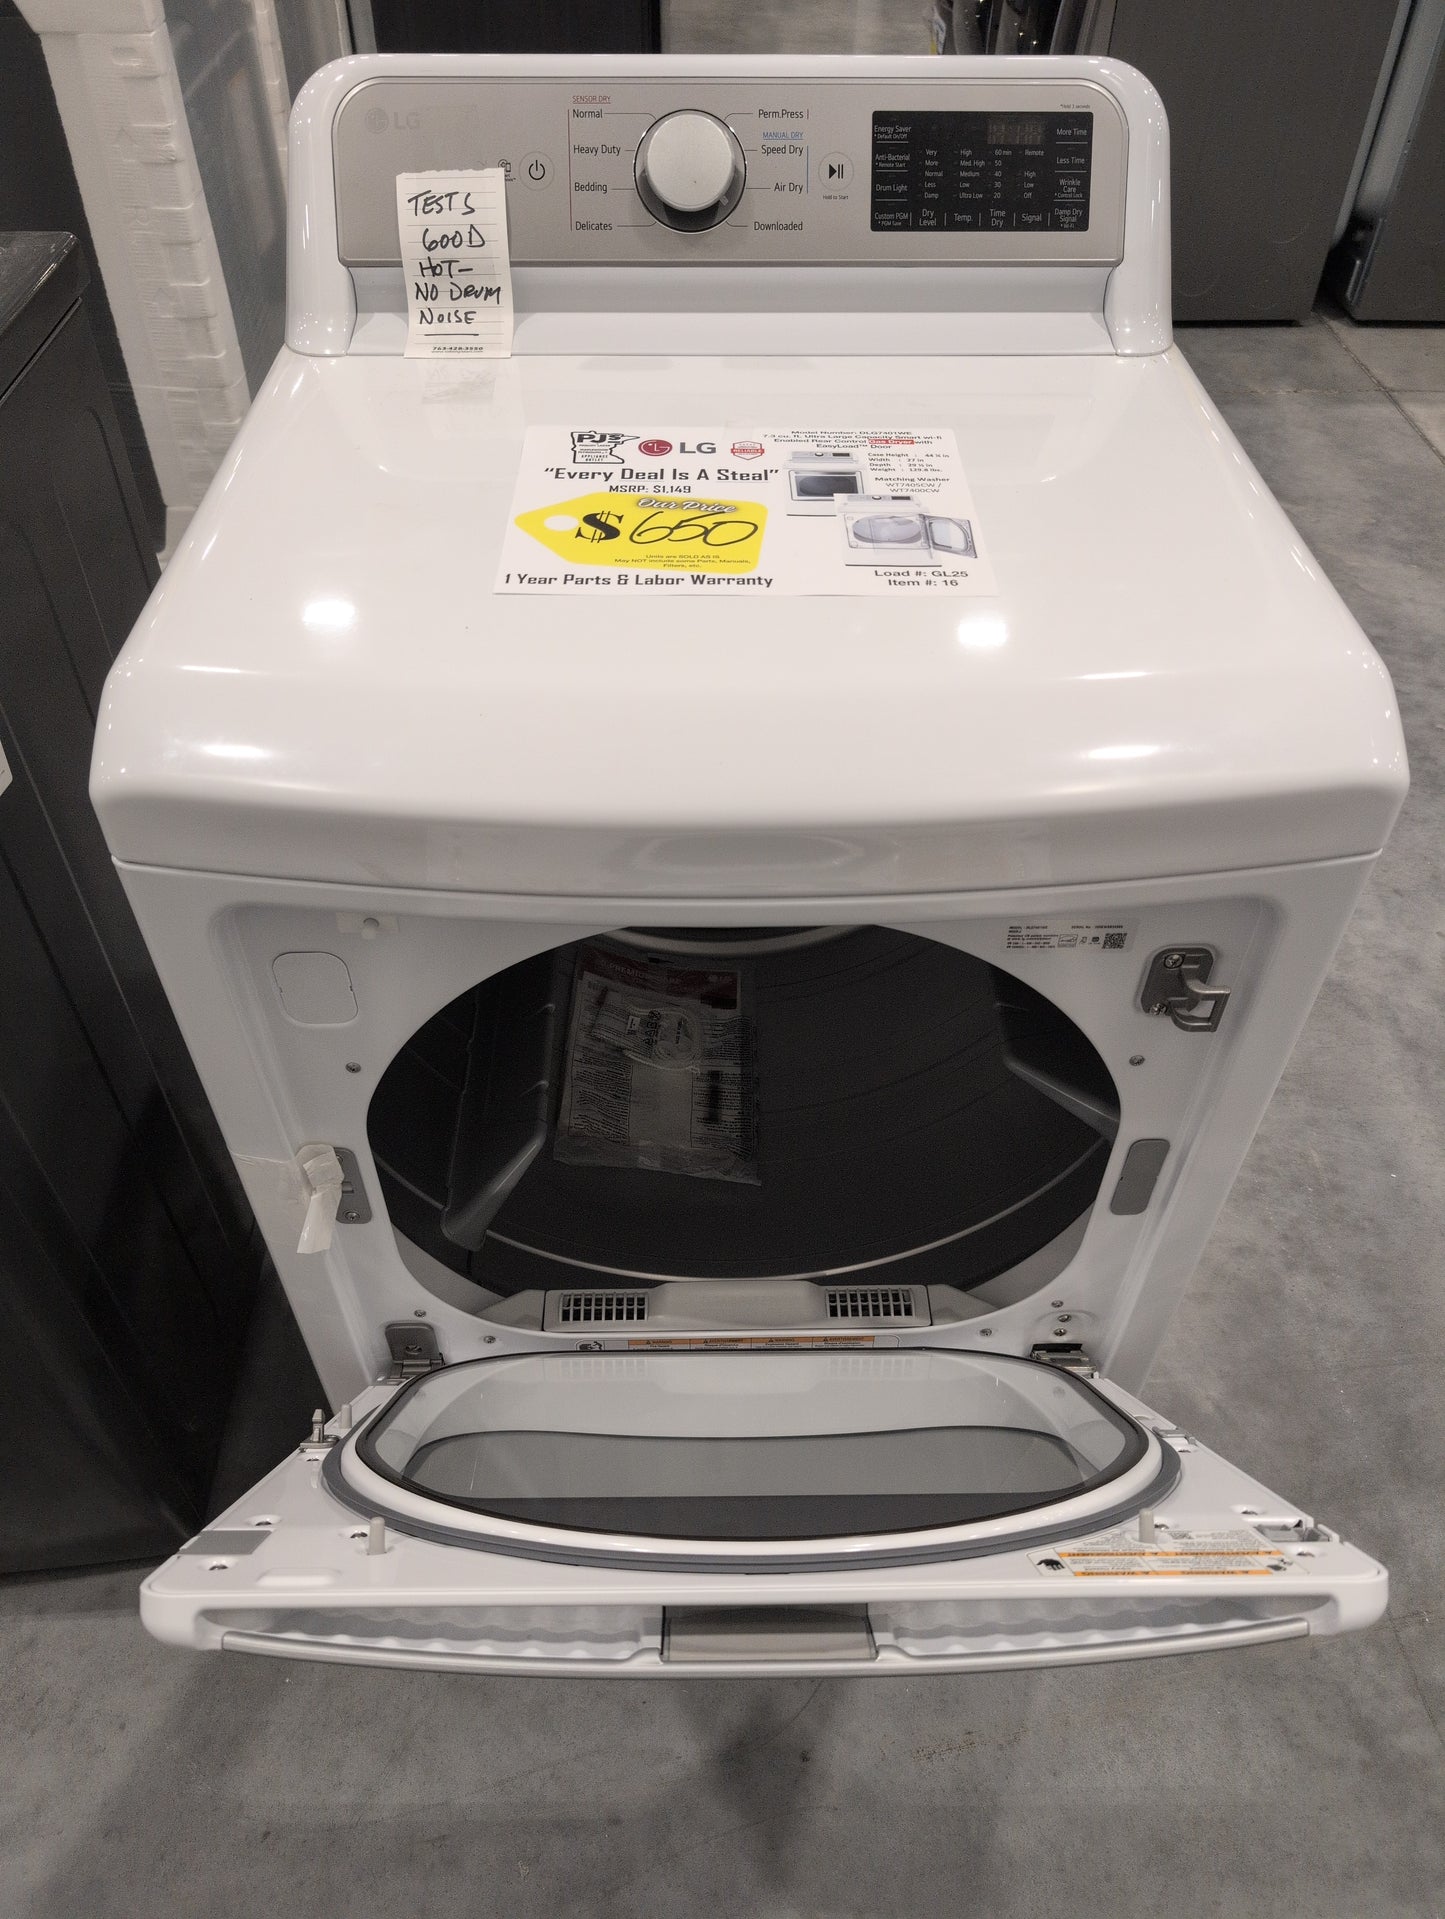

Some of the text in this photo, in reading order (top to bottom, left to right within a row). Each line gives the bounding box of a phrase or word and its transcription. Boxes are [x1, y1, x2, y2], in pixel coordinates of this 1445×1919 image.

[599, 95, 611, 103] DRY
[572, 109, 603, 119] Normal
[758, 109, 804, 119] Perm.Press
[874, 125, 894, 133] Energy
[1073, 128, 1088, 136] Time
[573, 145, 621, 156] Heavy Duty
[761, 145, 804, 156] Speed Dry
[926, 149, 938, 157] Very
[960, 149, 972, 157] High
[973, 160, 986, 168] High
[1056, 156, 1086, 164] Less Time
[1024, 170, 1036, 178] High
[1060, 178, 1080, 186] Wrinkle
[574, 182, 608, 193] Bedding
[774, 182, 804, 194] Air Dry
[893, 184, 908, 193] Light
[874, 212, 909, 220] Custom PGM
[922, 208, 934, 219] Dry
[990, 208, 1006, 217] Time
[1054, 208, 1083, 217] Damp Dry
[920, 218, 937, 226] Level
[991, 218, 1004, 228] Dry
[1022, 213, 1042, 224] Signal
[1060, 216, 1077, 224] Signal
[575, 221, 613, 231] Delicates
[754, 221, 804, 231] Downloaded
[415, 281, 501, 305] NO DRUM
[419, 309, 477, 325] NOISE
[680, 442, 716, 454] LG
[620, 468, 664, 480] Deal
[672, 468, 689, 480] Is
[696, 469, 710, 480] A
[609, 484, 692, 494] MSRP: $1,149
[638, 498, 737, 514] Our Price
[504, 574, 773, 588] 1 Year Parts & Labor Warranty
